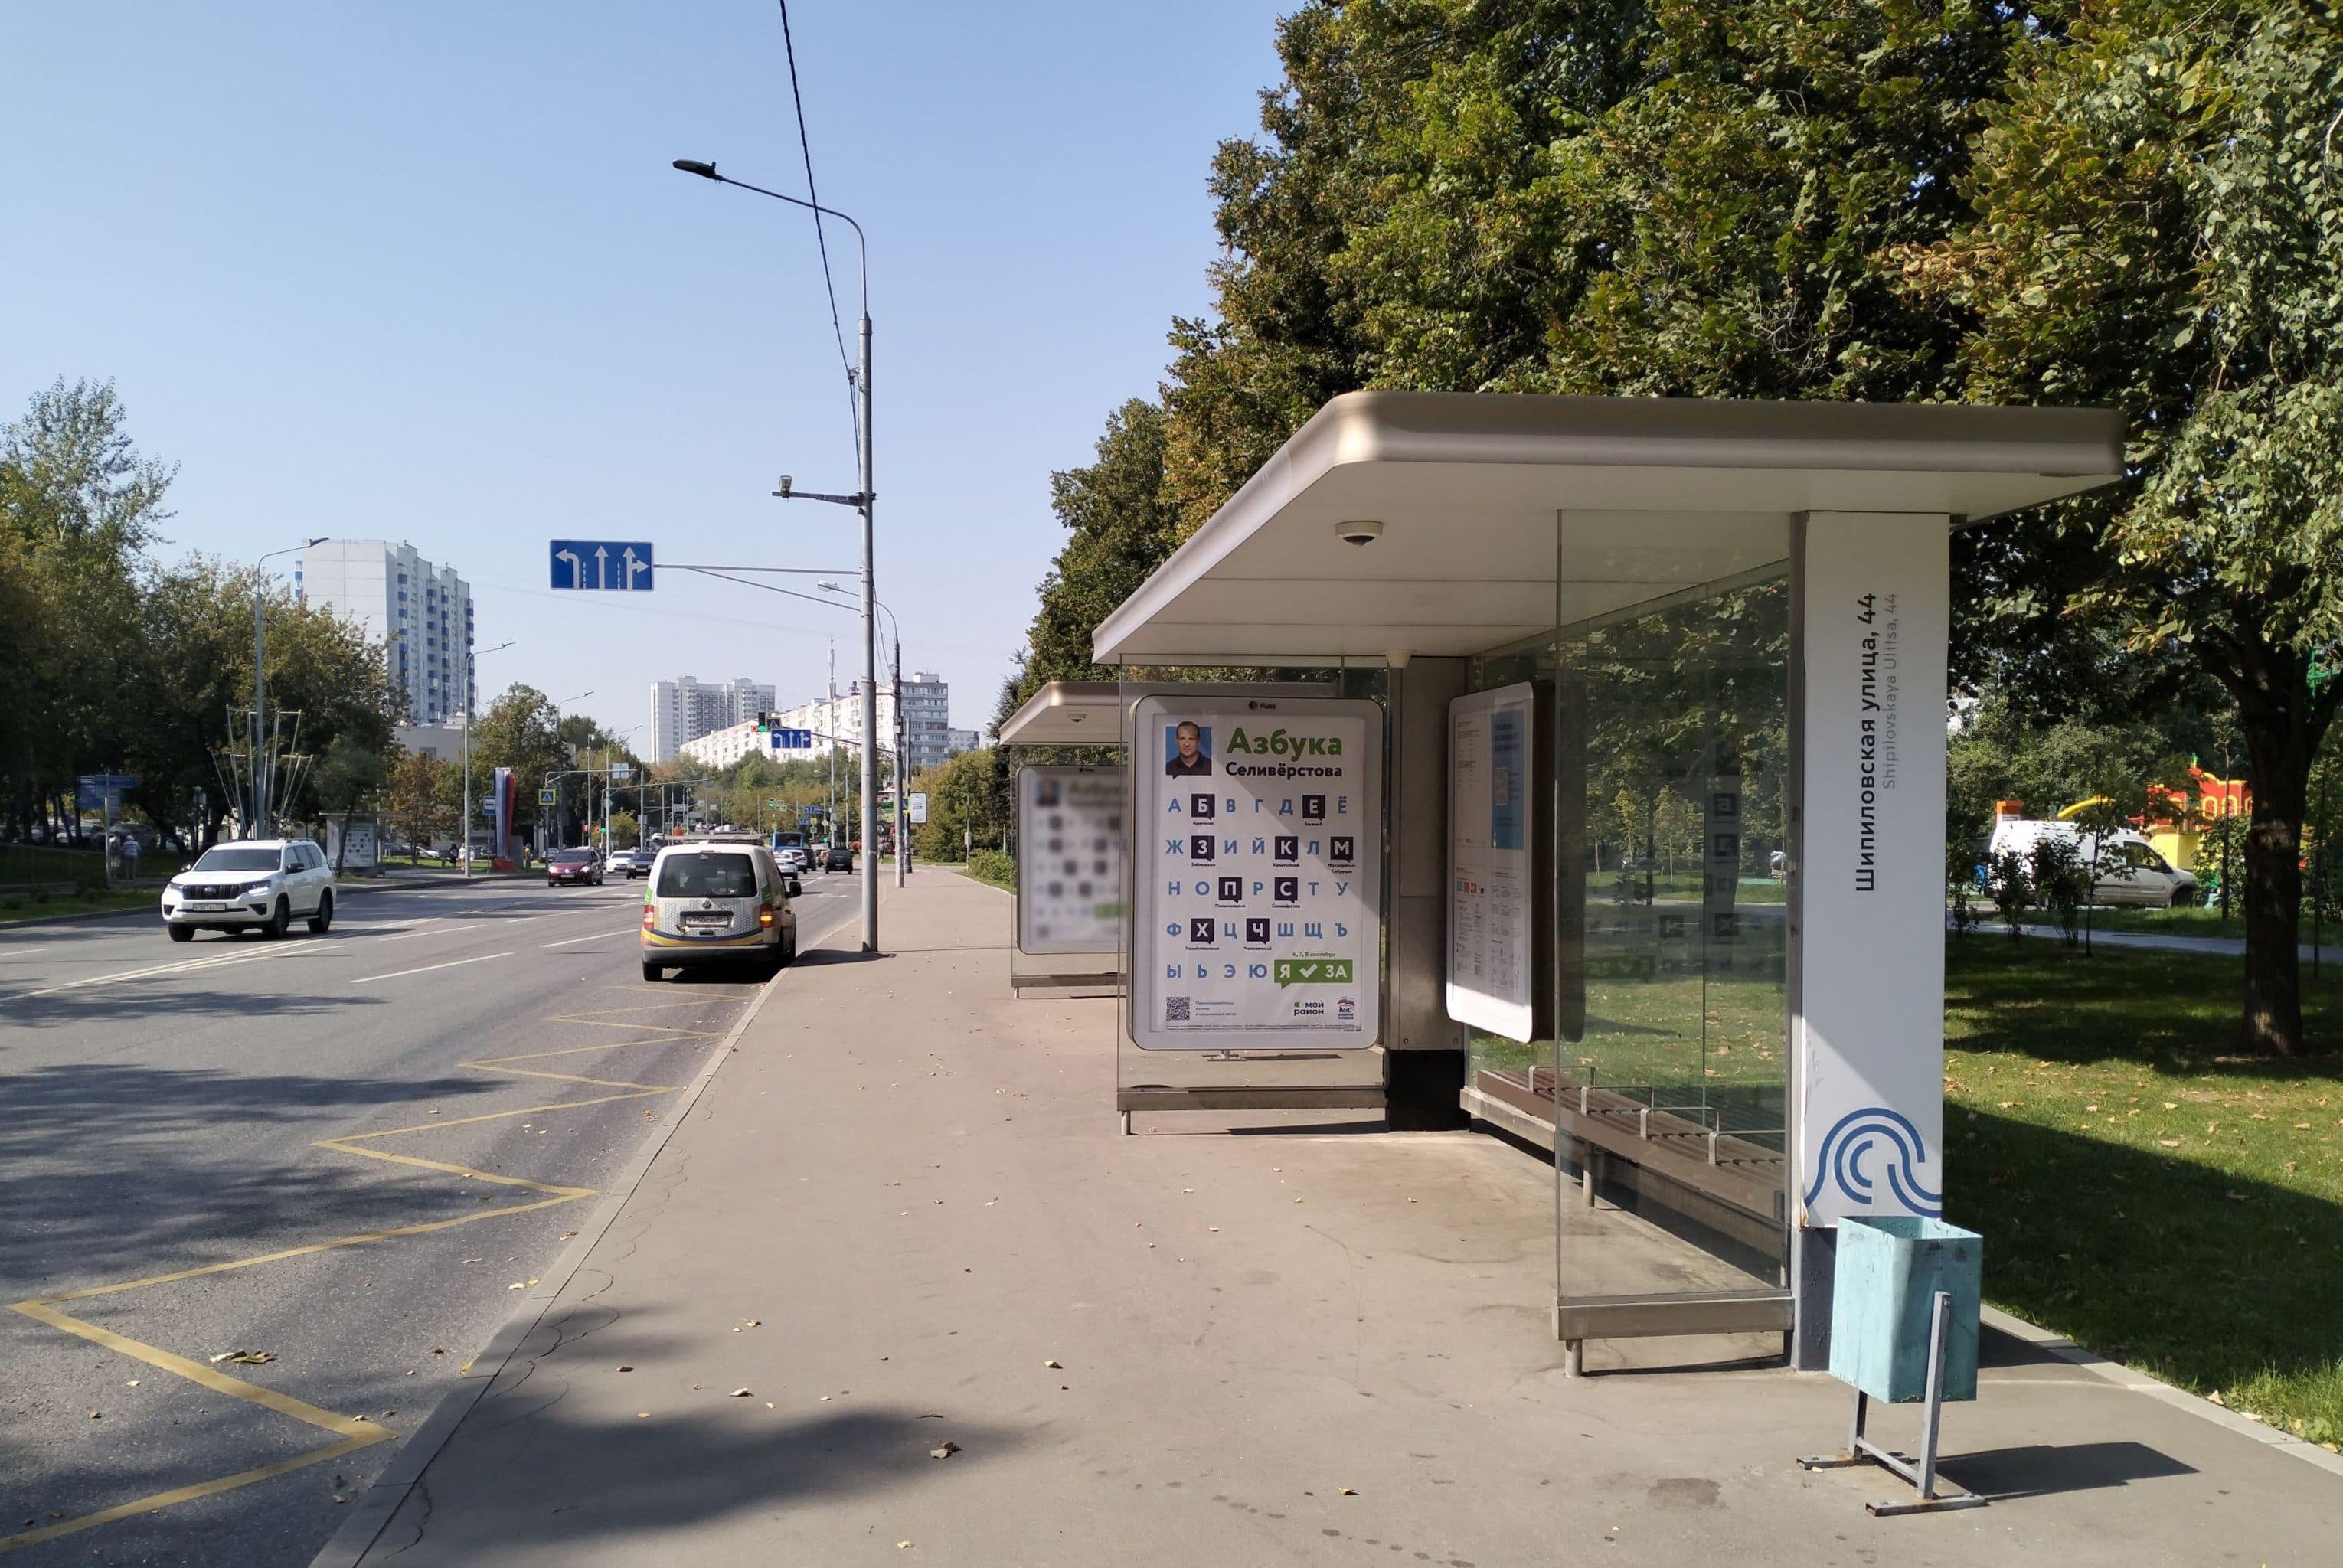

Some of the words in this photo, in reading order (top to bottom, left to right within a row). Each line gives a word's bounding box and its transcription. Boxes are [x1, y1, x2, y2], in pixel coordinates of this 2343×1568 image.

[1857, 593, 1876, 624] 44
[1883, 593, 1897, 614] 44
[1883, 619, 1900, 669] Ulitsa,
[1861, 631, 1880, 712] улица,
[1883, 675, 1900, 789] Shipilovskaya
[1226, 727, 1342, 762] Азбука
[1225, 761, 1342, 780] Селивёрстова
[1168, 799, 1182, 812] А
[1198, 799, 1208, 812] Б
[1226, 799, 1236, 813] В
[1255, 799, 1263, 813] Г
[1279, 799, 1294, 815] Д
[1309, 799, 1319, 813] Е
[1338, 795, 1347, 814] Ё
[1856, 720, 1875, 892] Шипиловская
[1165, 840, 1184, 854] Ж
[1198, 840, 1208, 854] З
[1224, 840, 1237, 854] И
[1252, 837, 1265, 854] Й
[1280, 841, 1292, 855] К
[1307, 841, 1319, 854] Л
[1335, 841, 1349, 855] М
[1168, 881, 1181, 895] Н
[1195, 881, 1210, 896] О
[1225, 882, 1236, 896] П
[1253, 882, 1263, 895] Р
[1279, 881, 1292, 896] С
[1308, 882, 1319, 896] Т
[1336, 882, 1348, 896] У
[1167, 923, 1182, 937] Ф
[1196, 923, 1209, 937] Х
[1224, 923, 1237, 939] Ц
[1252, 923, 1263, 937] Ч
[1277, 923, 1294, 937] Ш
[1305, 923, 1323, 939] Щ
[1335, 923, 1348, 937] Ъ
[1166, 964, 1181, 978] Ы
[1198, 965, 1207, 978] Ь
[1224, 964, 1236, 978] Э
[1249, 964, 1268, 979] Ю
[1279, 964, 1290, 978] Я
[1325, 964, 1348, 978] ЗА
